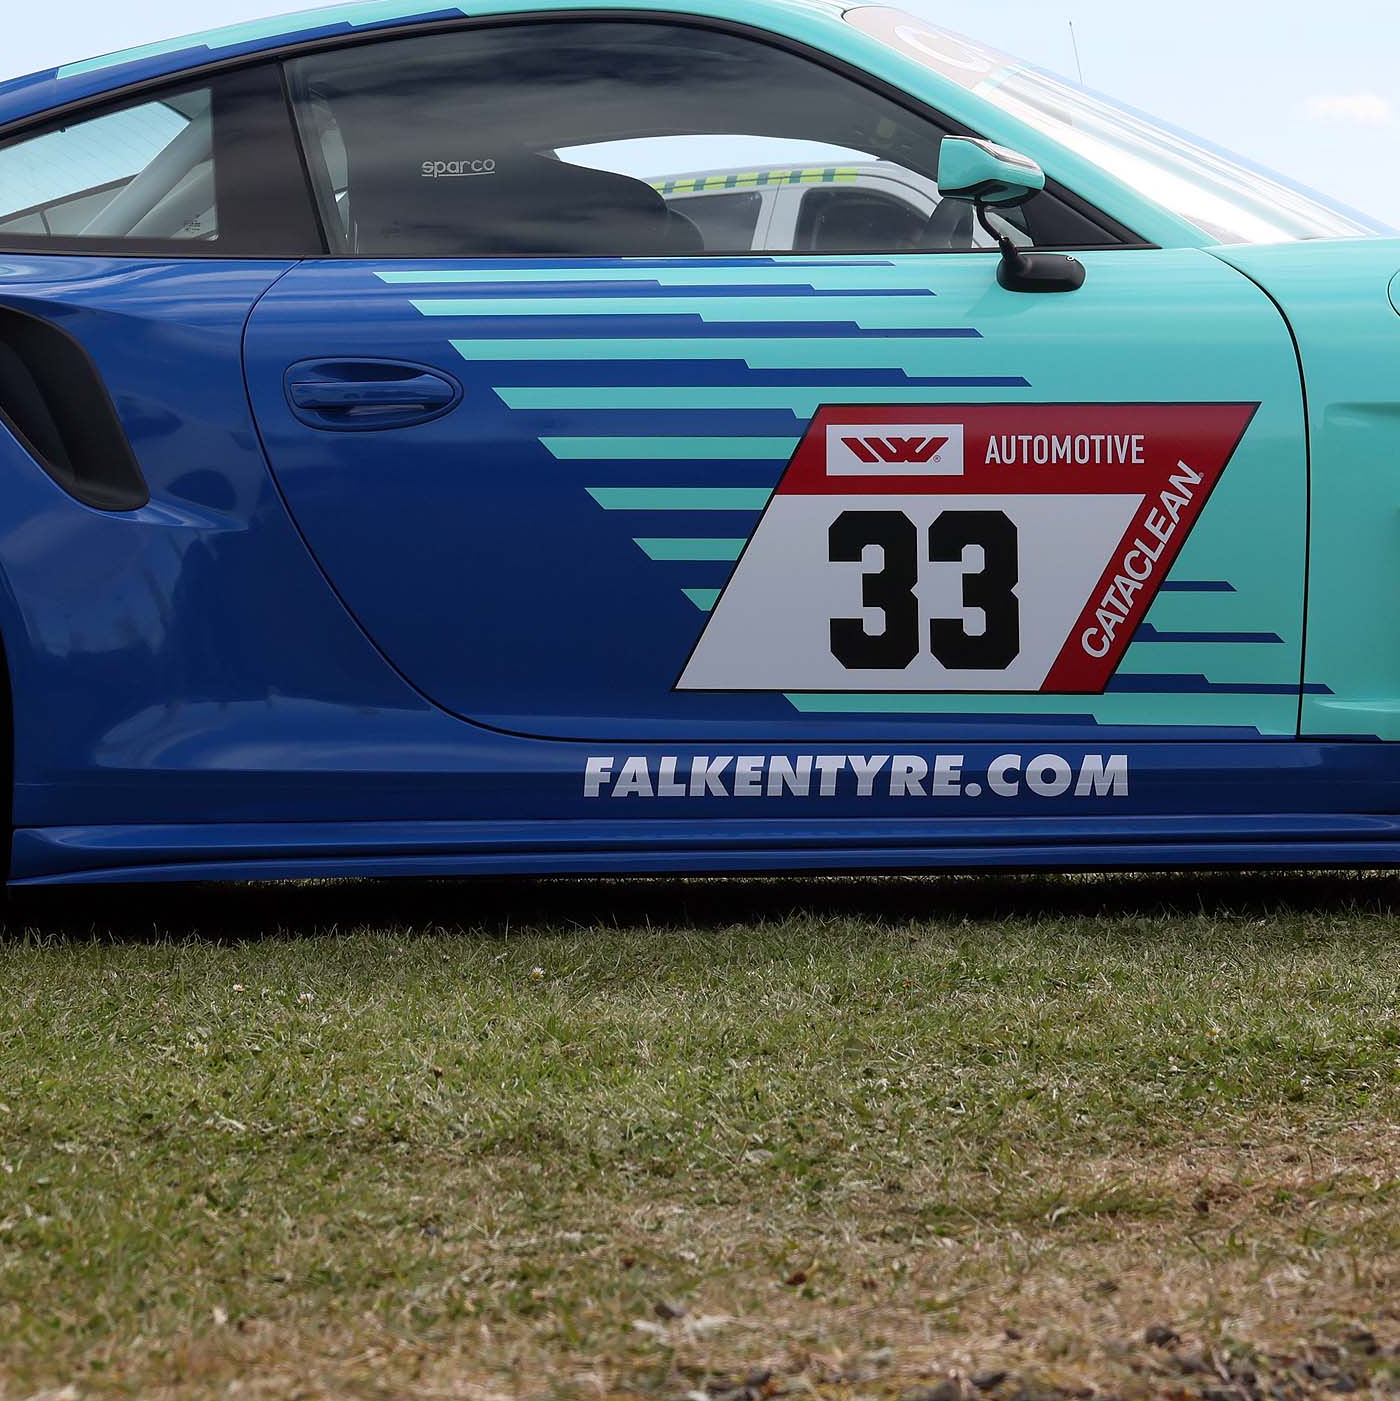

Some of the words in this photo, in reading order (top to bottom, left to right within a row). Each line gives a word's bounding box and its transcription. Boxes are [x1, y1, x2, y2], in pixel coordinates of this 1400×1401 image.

[421, 158, 496, 178] sparco
[984, 434, 1145, 465] AUTOMOTIVE
[1081, 459, 1202, 659] CATACLEAN
[828, 510, 1020, 670] 33
[583, 753, 1129, 798] FALKENTYRE.COM
